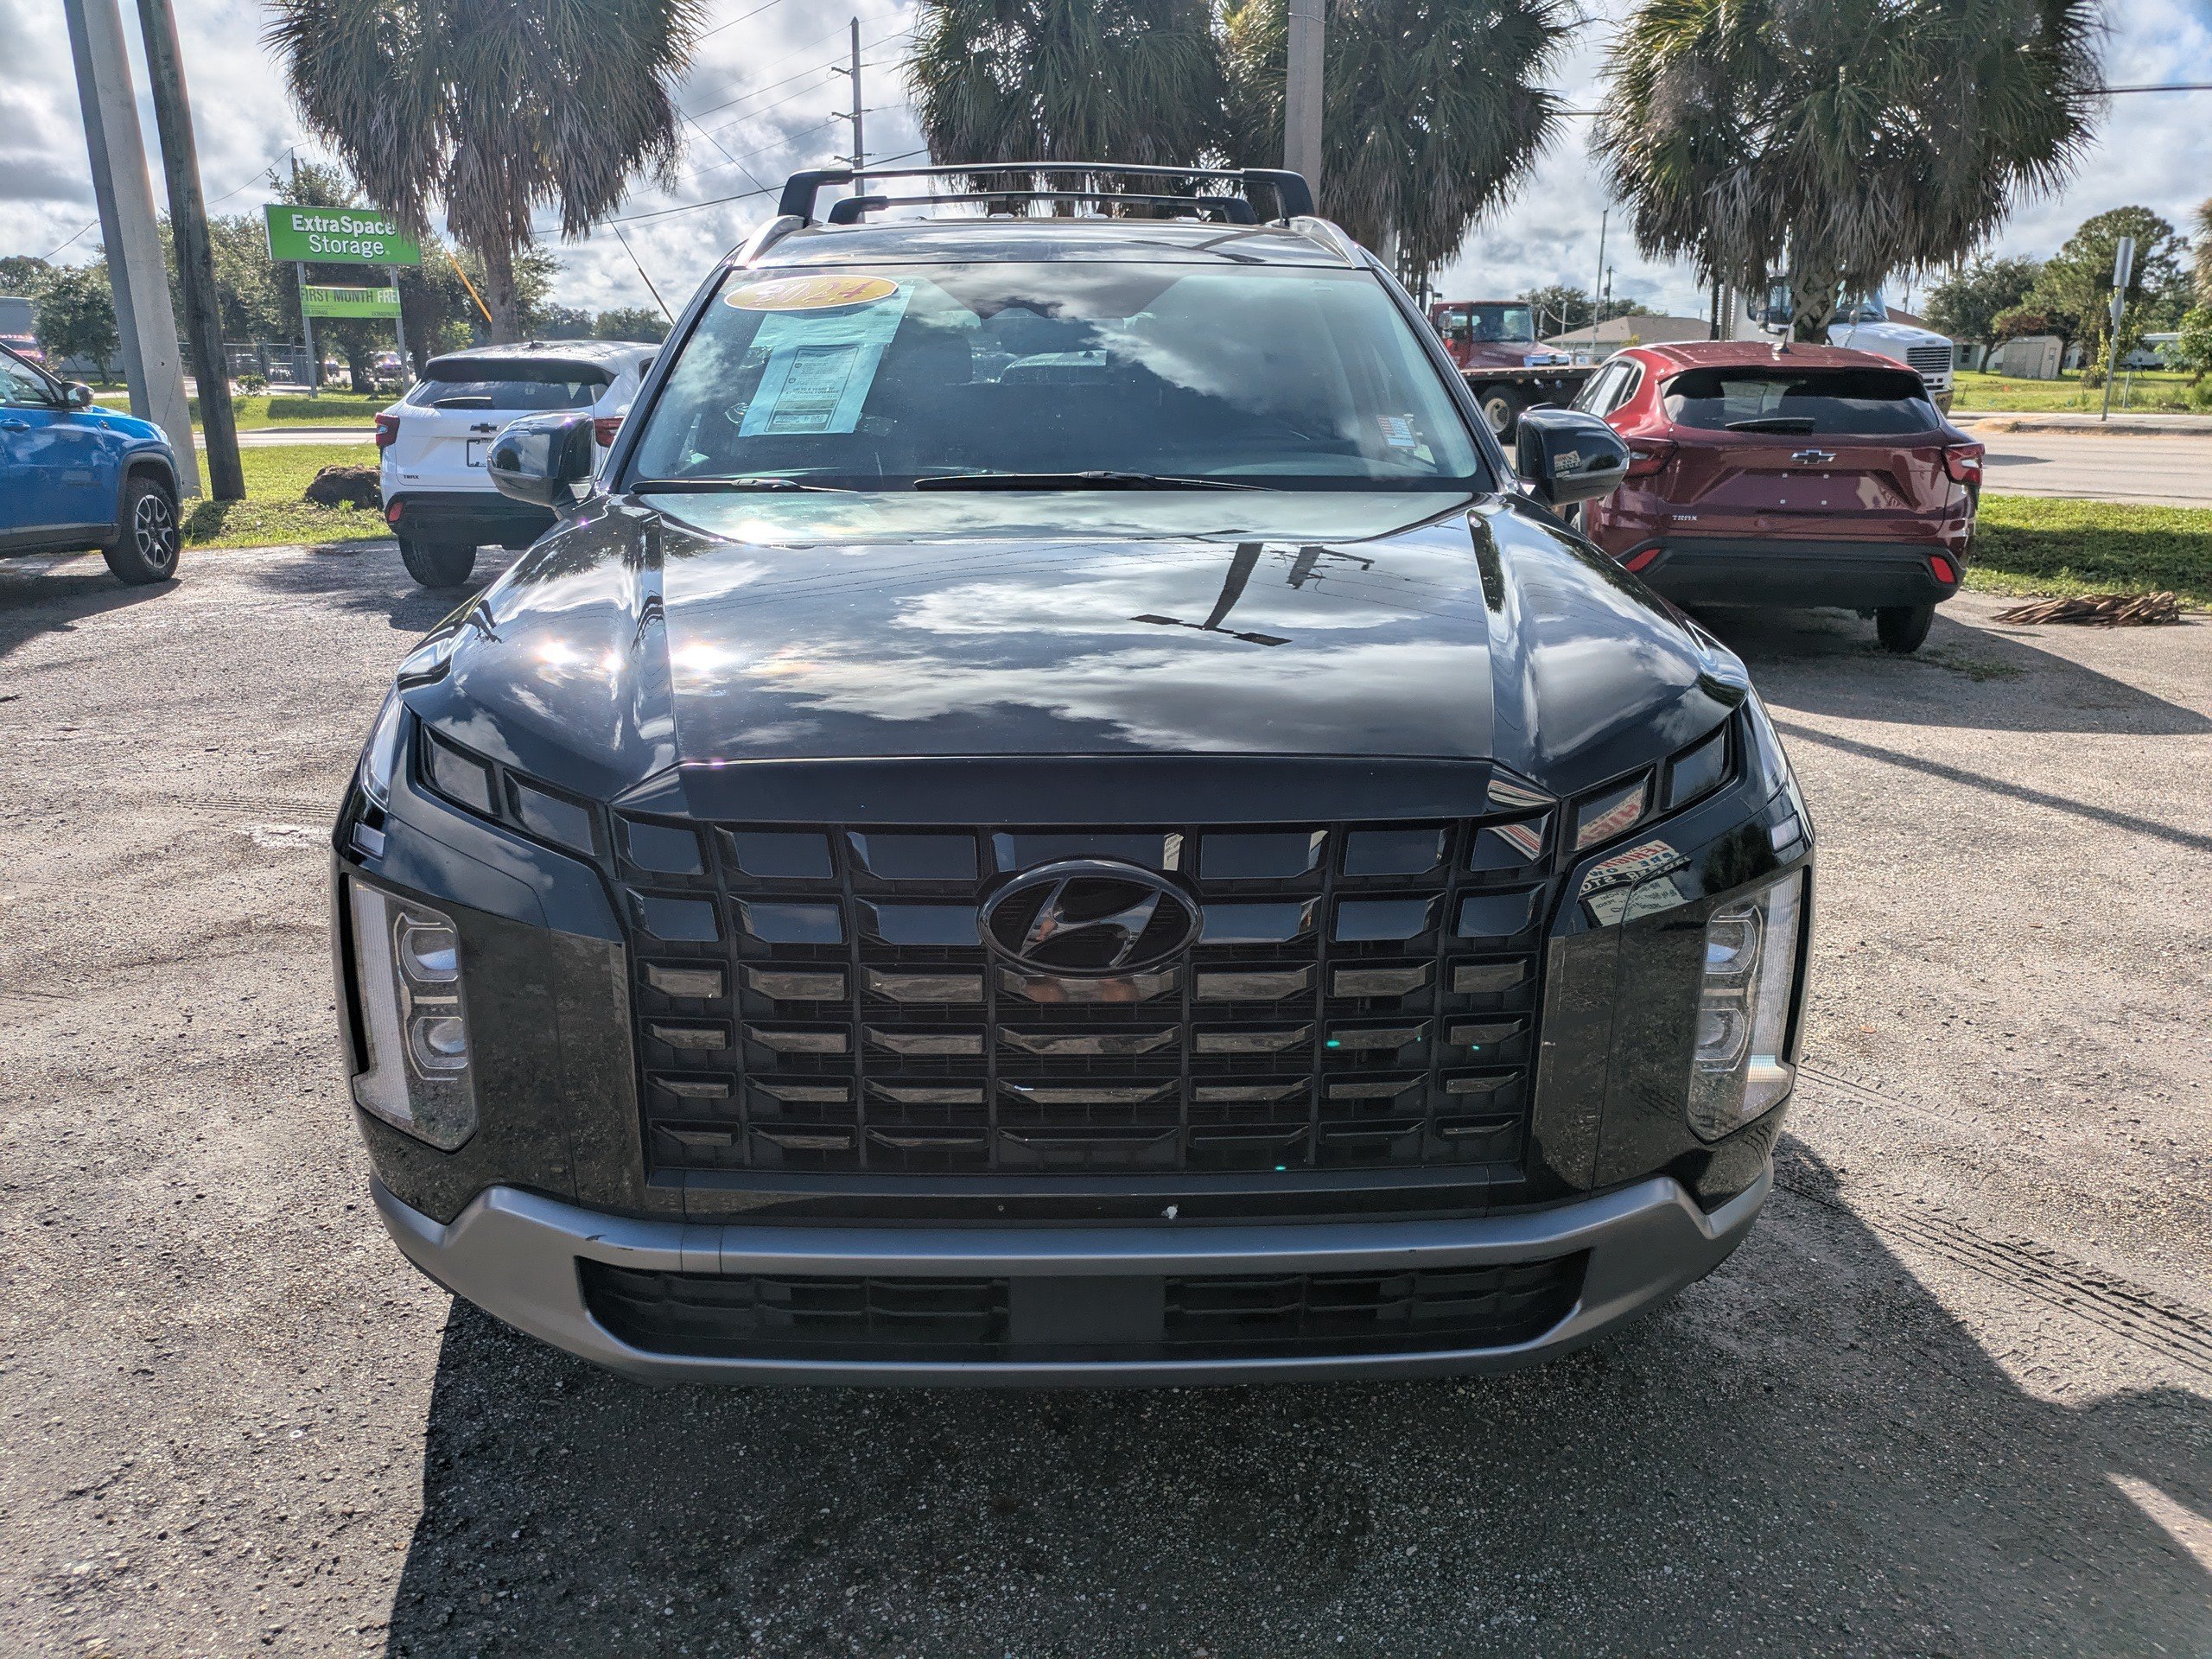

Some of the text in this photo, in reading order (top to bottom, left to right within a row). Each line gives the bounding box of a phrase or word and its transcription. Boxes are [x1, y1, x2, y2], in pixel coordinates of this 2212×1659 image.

[291, 213, 396, 238] ExtraSpace
[308, 234, 385, 257] Storage
[301, 287, 329, 302] FIRST
[334, 289, 374, 302] MONTH
